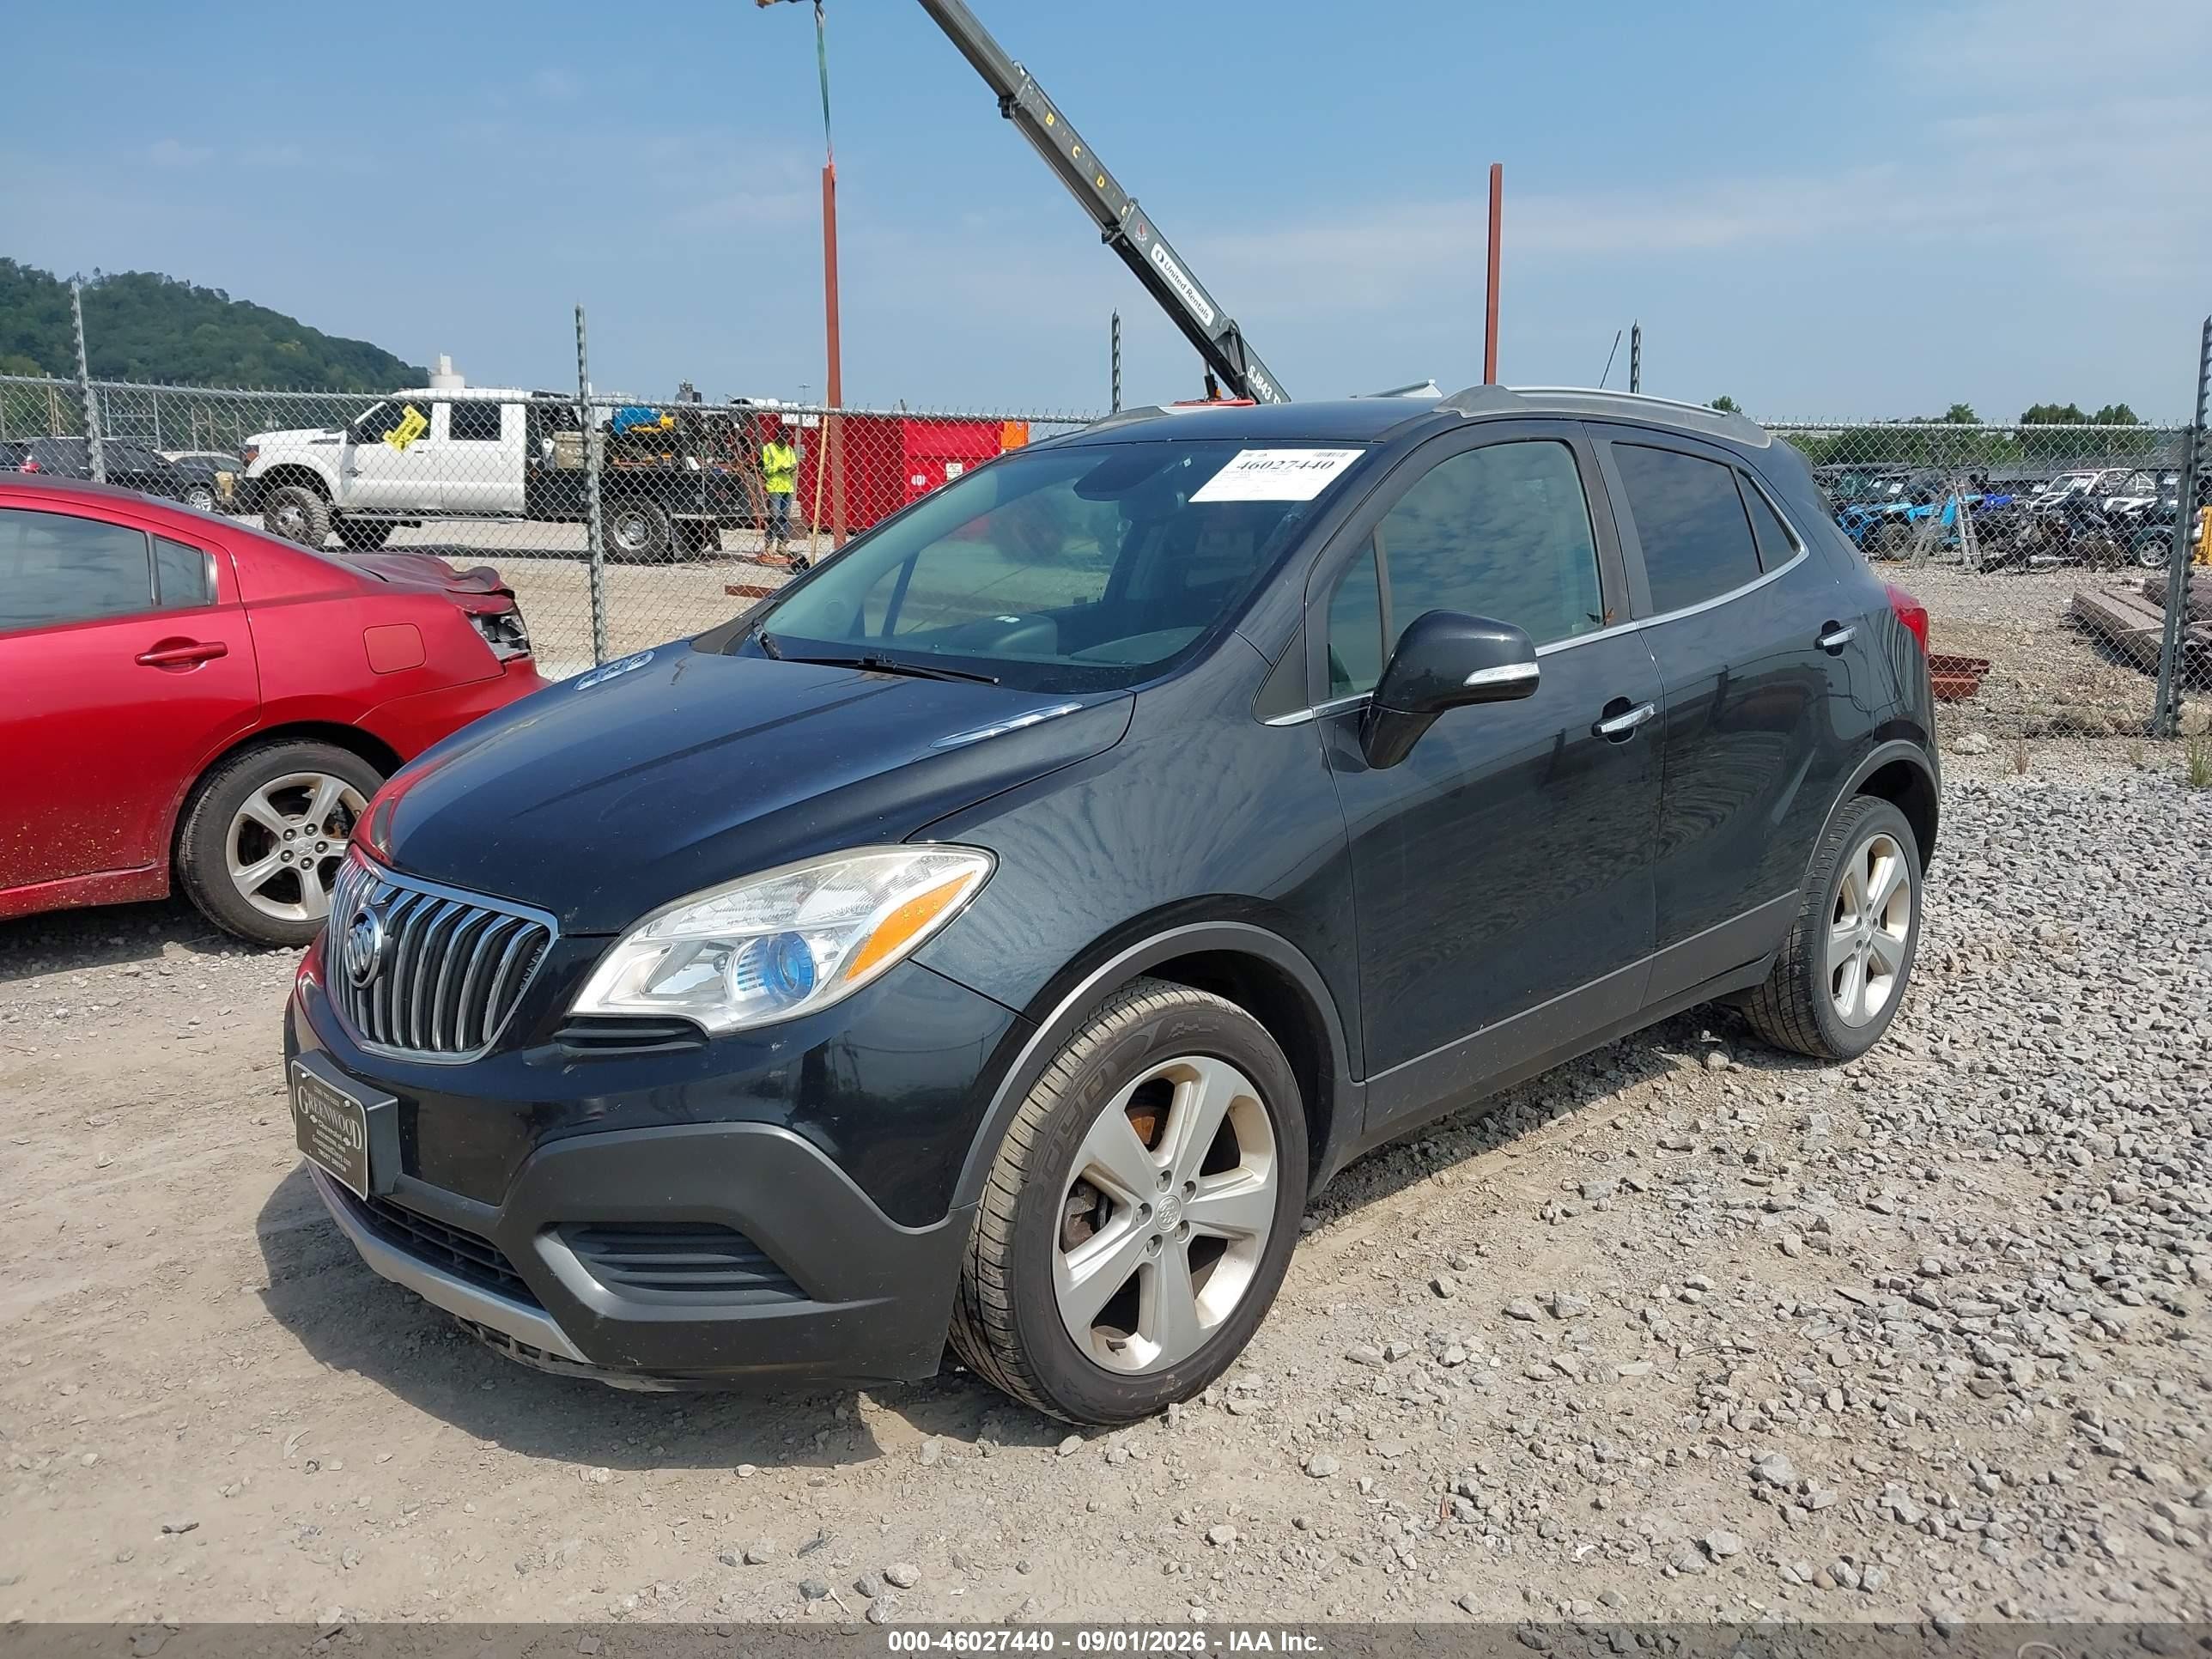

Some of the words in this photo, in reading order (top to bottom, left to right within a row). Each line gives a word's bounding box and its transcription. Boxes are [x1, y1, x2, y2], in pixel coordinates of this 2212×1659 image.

[1045, 112, 1054, 126] B
[1072, 145, 1081, 159] C
[1096, 174, 1105, 187] D
[1164, 261, 1187, 290] United
[1185, 288, 1209, 319] Rentals
[1247, 364, 1273, 400] SJ843
[1237, 460, 1334, 470] 46027440
